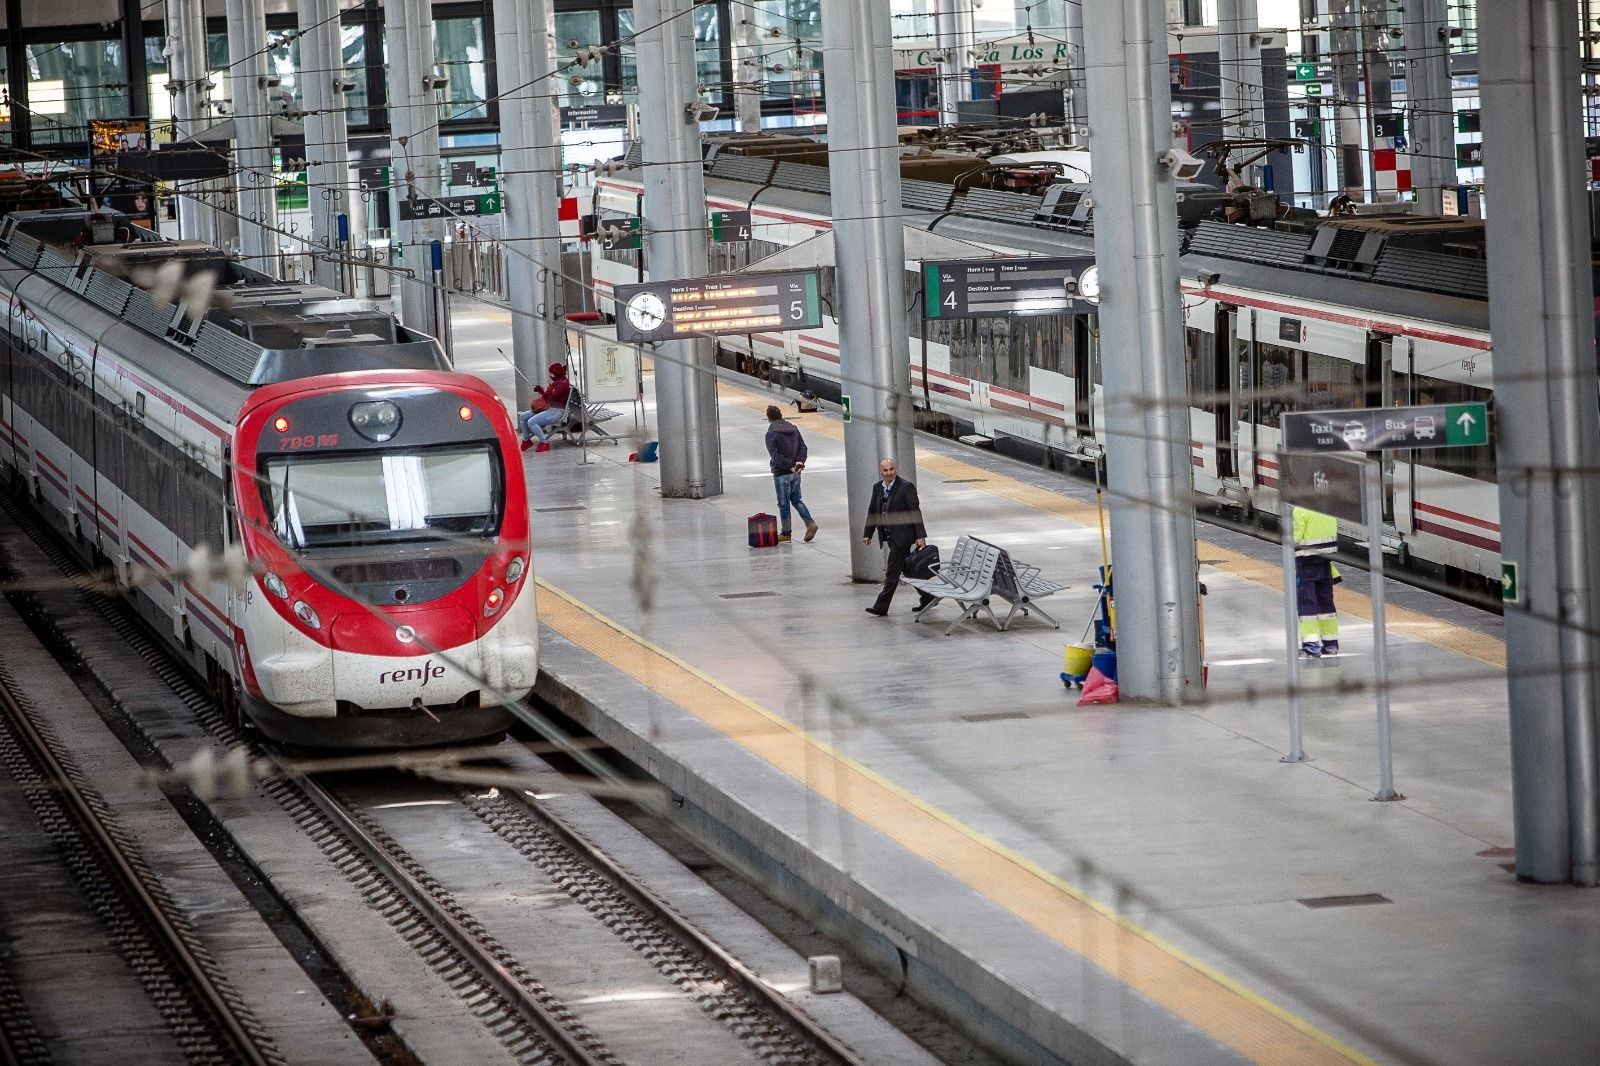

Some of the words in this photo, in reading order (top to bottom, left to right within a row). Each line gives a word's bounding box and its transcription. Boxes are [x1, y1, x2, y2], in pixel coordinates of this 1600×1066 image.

[1011, 45, 1044, 61] Los
[1055, 43, 1067, 58] R
[1296, 128, 1303, 137] 2
[1376, 126, 1383, 137] 3
[466, 172, 474, 185] 4
[738, 226, 749, 240] 4
[943, 290, 957, 310] 4
[790, 300, 803, 320] 5
[1309, 421, 1333, 434] Taxi
[1384, 419, 1407, 430] Bus
[379, 659, 446, 687] renfe
